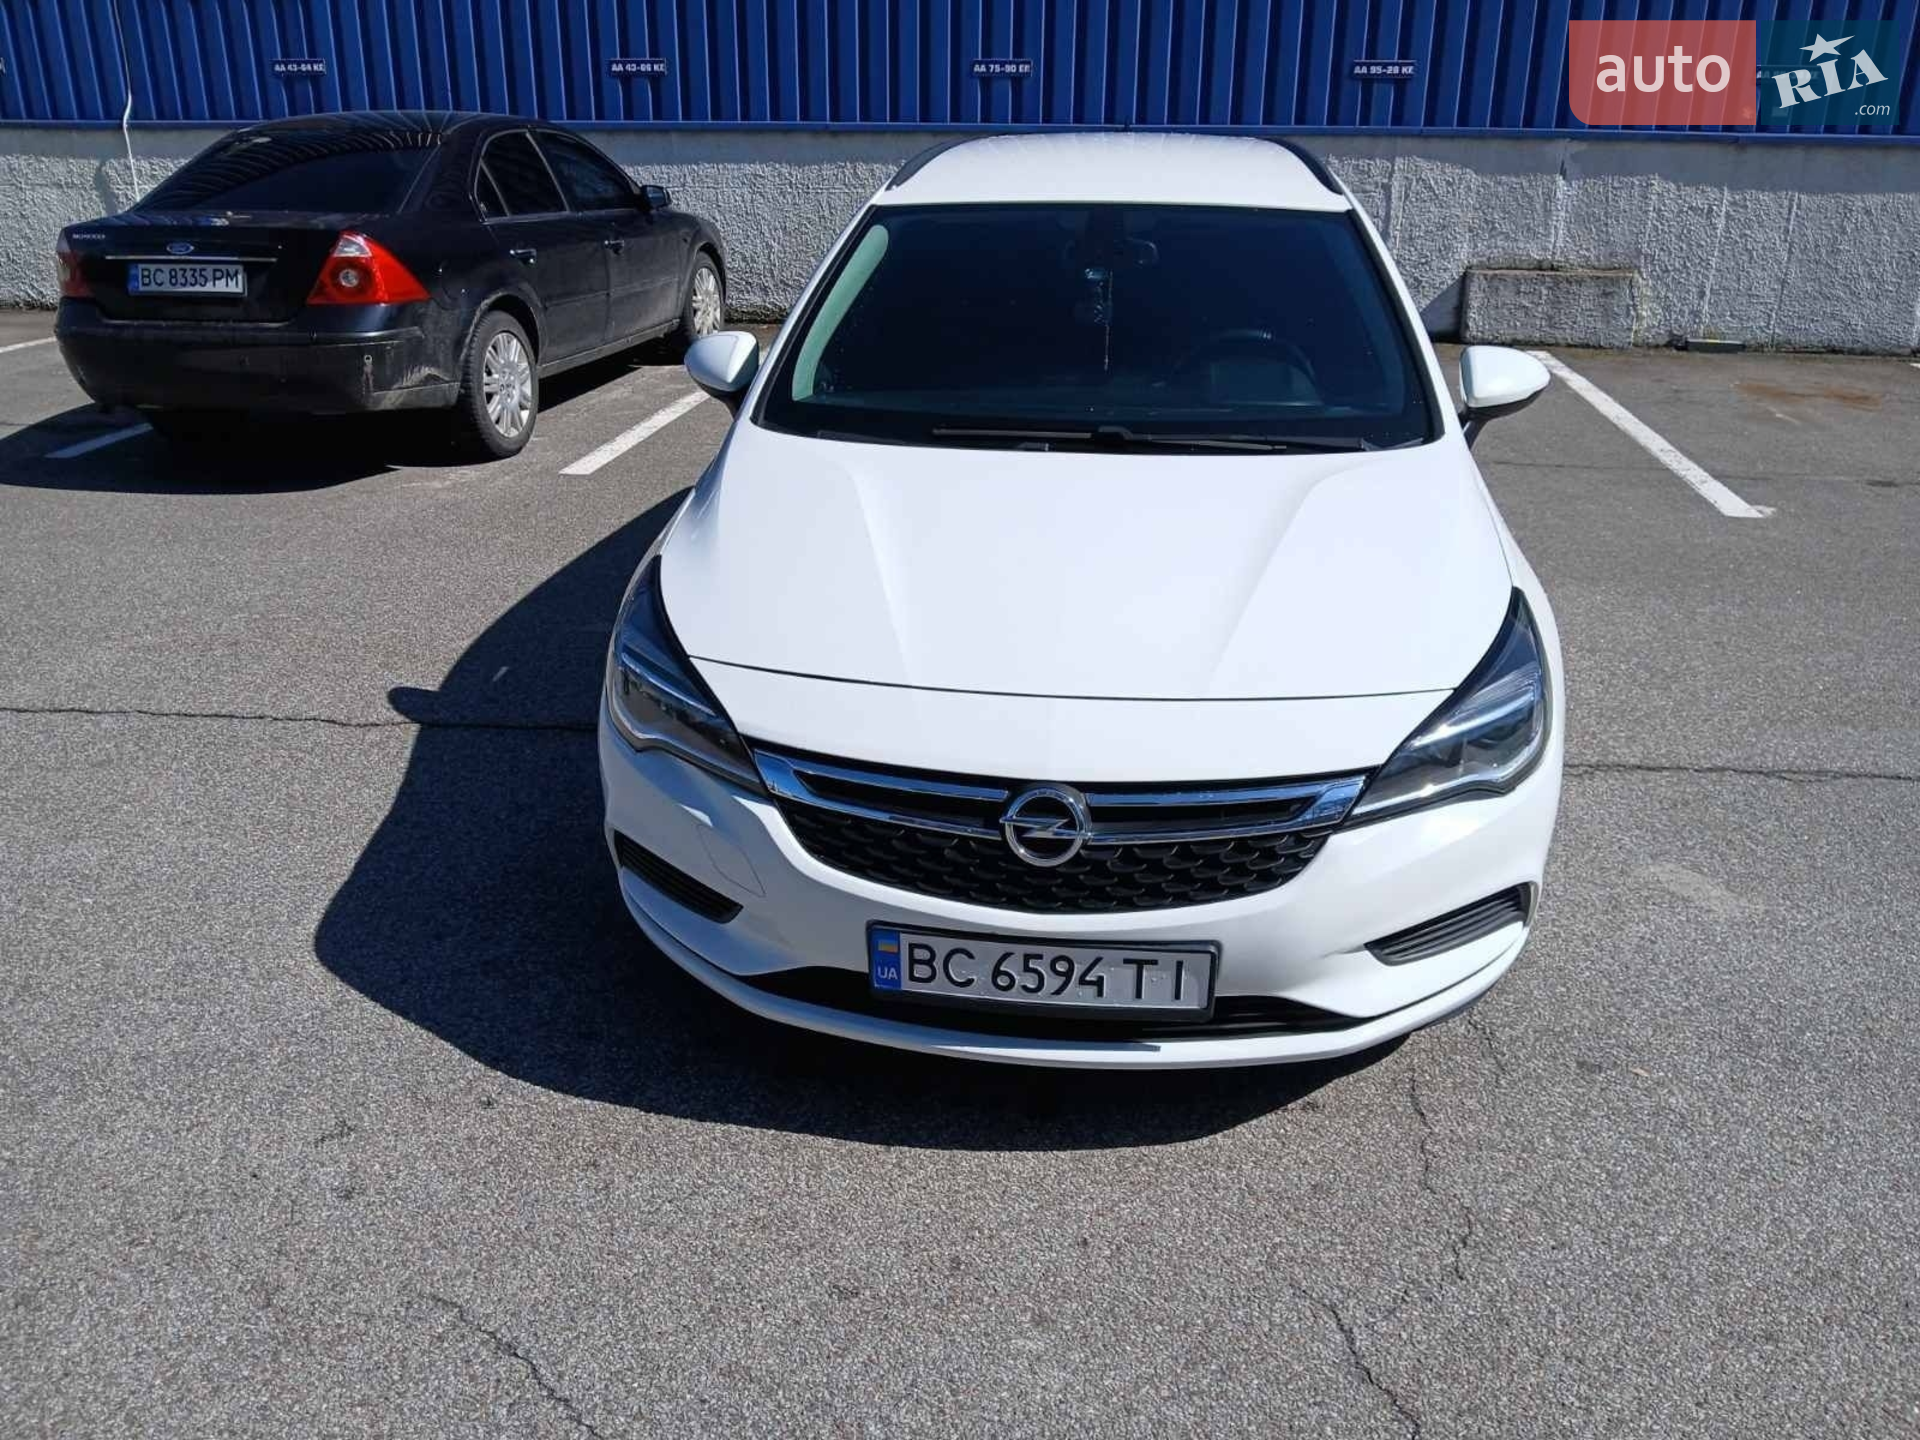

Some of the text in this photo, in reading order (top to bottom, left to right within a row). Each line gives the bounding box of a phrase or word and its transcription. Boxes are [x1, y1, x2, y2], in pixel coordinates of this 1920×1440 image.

[141, 267, 164, 287] BC
[168, 267, 209, 288] 8335
[212, 267, 239, 289] PM
[877, 965, 899, 981] UA
[907, 942, 976, 989] BC
[990, 952, 1105, 998] 6594
